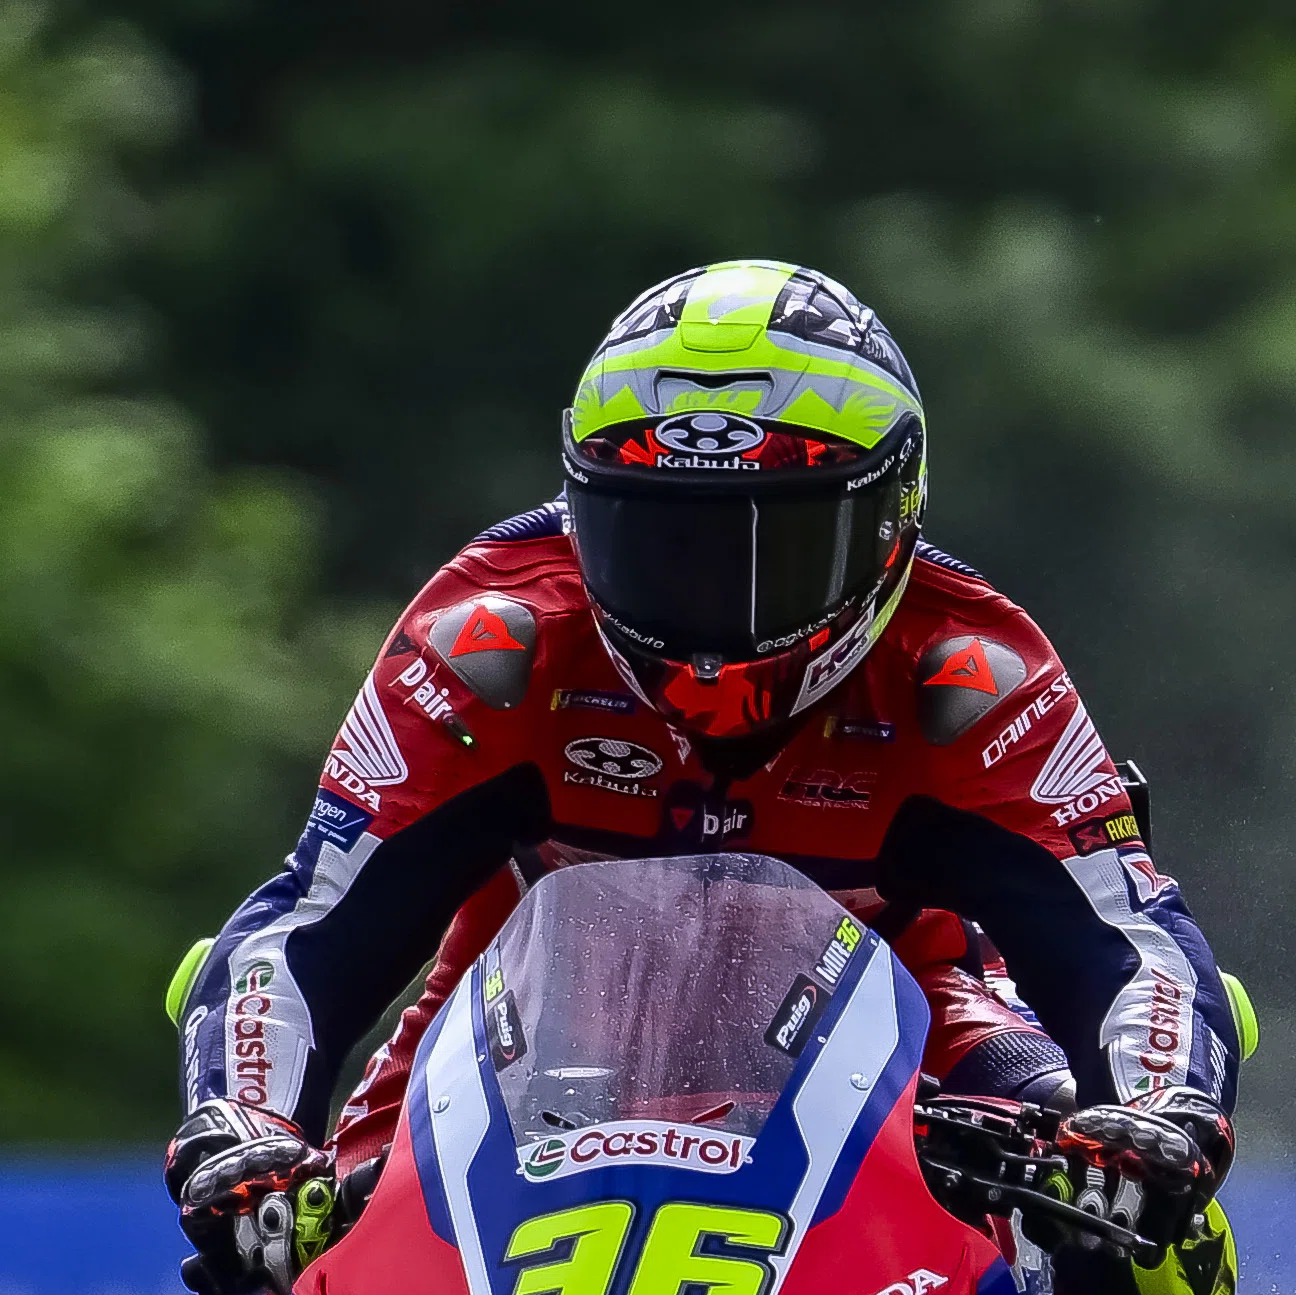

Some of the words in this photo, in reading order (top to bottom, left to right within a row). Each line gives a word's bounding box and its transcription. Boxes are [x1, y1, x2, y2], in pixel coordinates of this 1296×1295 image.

[656, 454, 761, 471] Kabuto
[981, 671, 1074, 769] DAINESE
[323, 756, 381, 812] NDA
[1050, 775, 1127, 828] HON
[776, 994, 811, 1047] Puig
[234, 993, 274, 1107] Castro
[569, 1127, 742, 1169] Castrol
